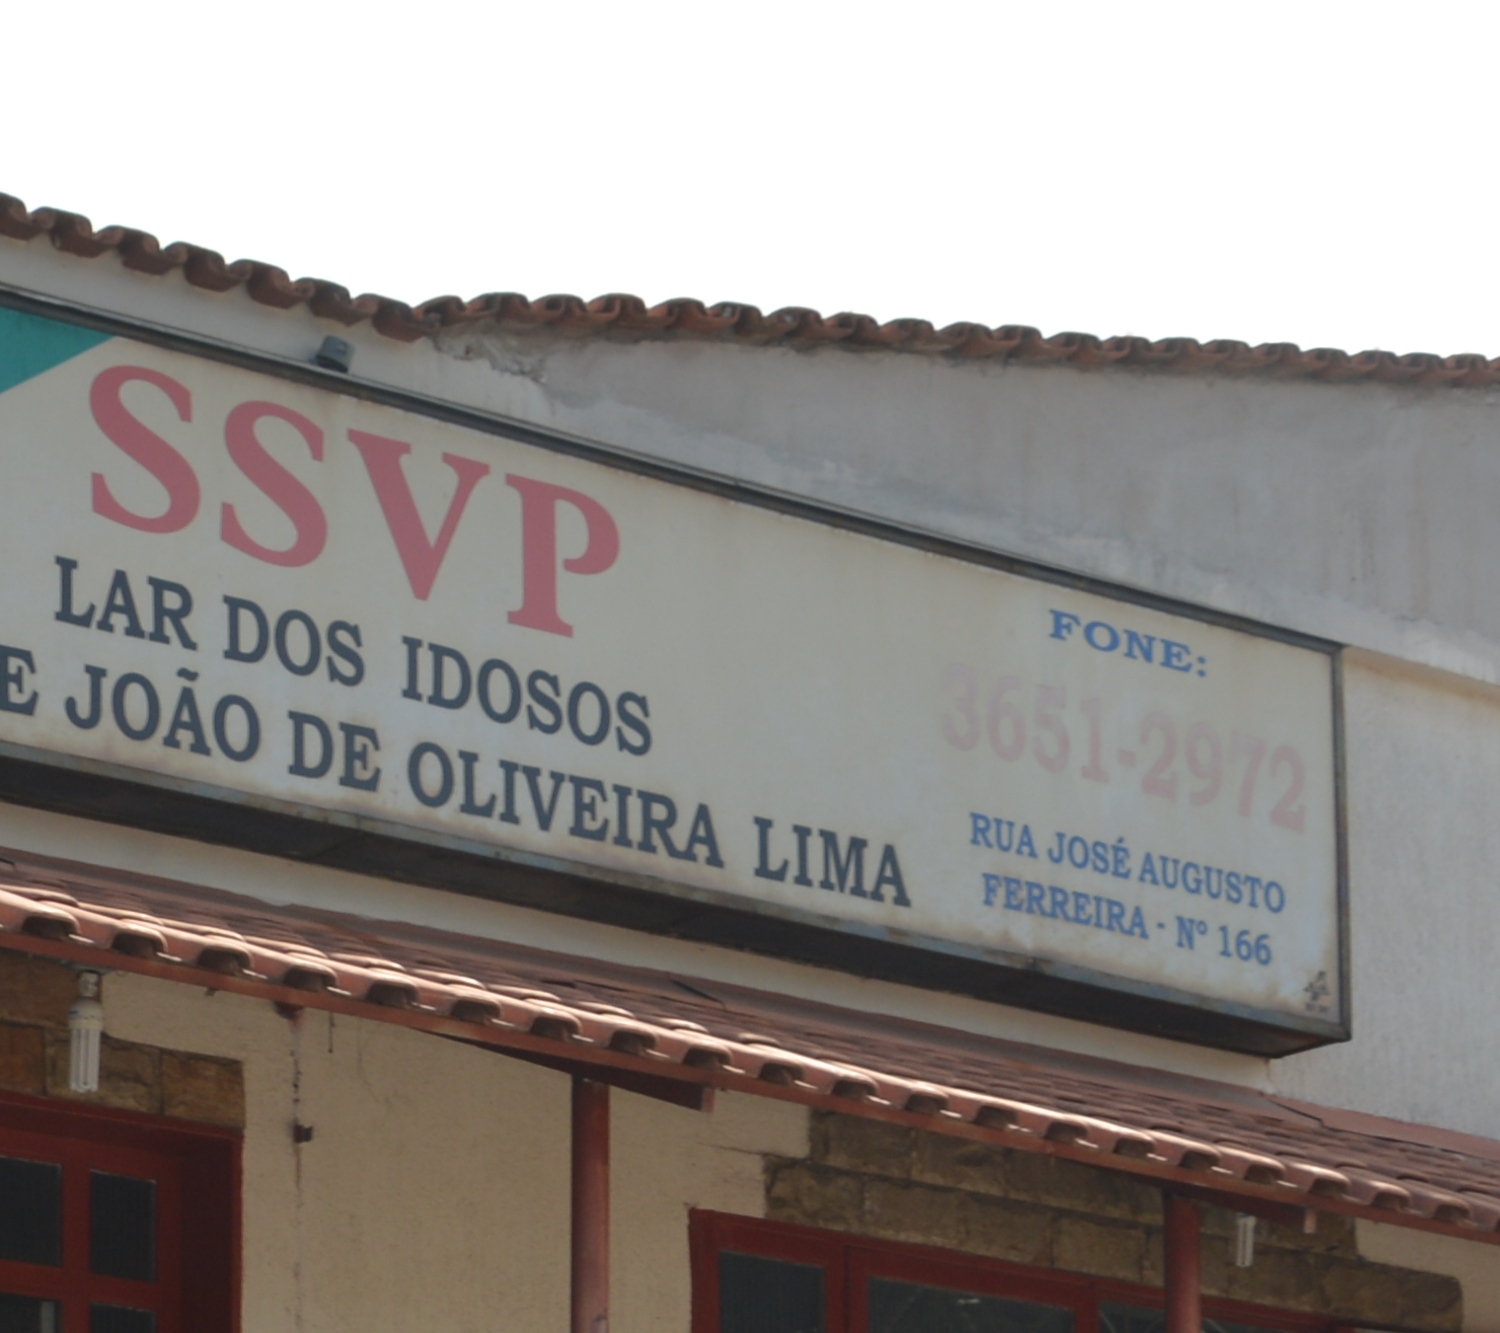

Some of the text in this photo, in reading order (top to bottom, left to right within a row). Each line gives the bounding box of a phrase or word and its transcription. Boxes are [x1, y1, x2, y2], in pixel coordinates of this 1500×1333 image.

[89, 364, 621, 638] SSVP
[54, 555, 653, 757] LAR DOS IDOSOS
[1048, 608, 1208, 677] FONE:
[65, 664, 262, 763] JOÃO
[287, 710, 382, 793] DE
[407, 740, 725, 870] OLIVEIRA
[753, 815, 912, 908] LIMA
[940, 662, 1307, 835] 3651-2972
[969, 811, 1287, 913] RUA JOSÉ AUGUSTO
[982, 872, 1149, 940] FERREIRA
[1219, 925, 1273, 966] 166
